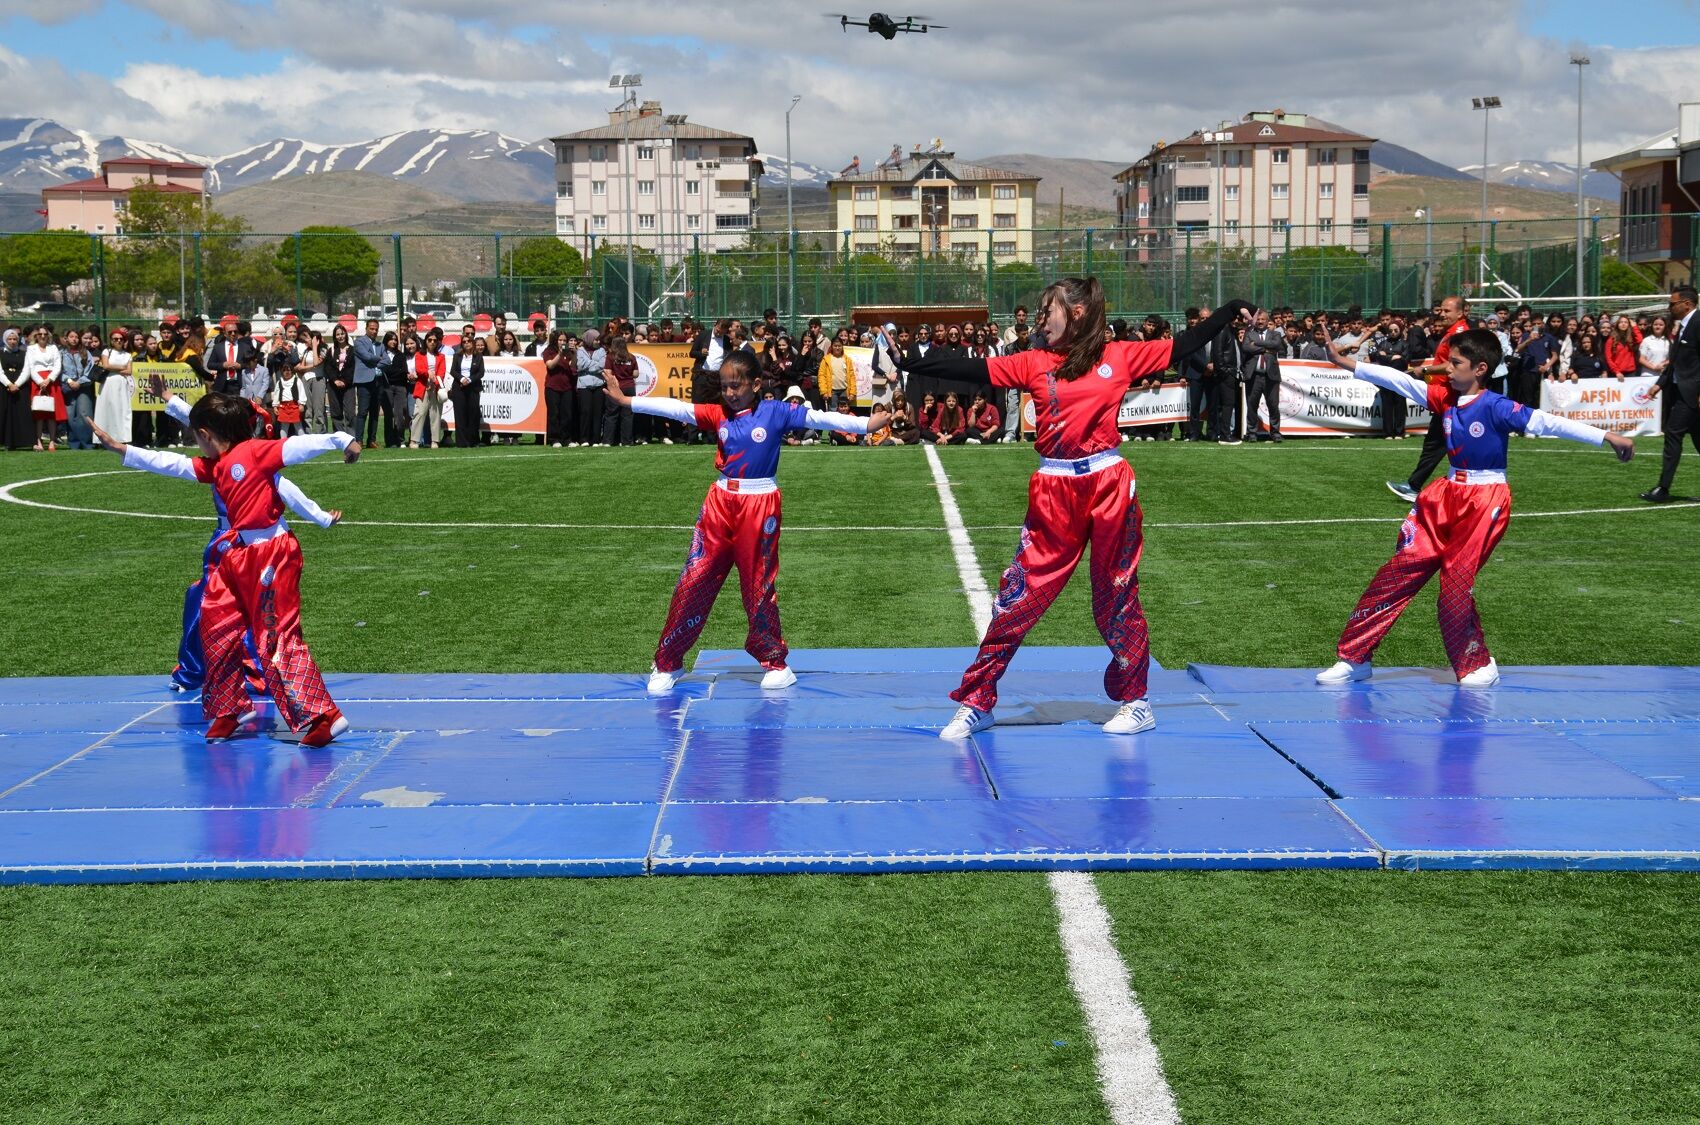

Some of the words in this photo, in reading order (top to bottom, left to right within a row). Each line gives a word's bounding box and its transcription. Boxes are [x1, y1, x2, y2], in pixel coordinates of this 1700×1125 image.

[668, 367, 693, 381] AF
[163, 376, 203, 389] ARAOĞLAN
[495, 380, 513, 395] HAKAN
[514, 381, 532, 395] AKYAR
[138, 392, 156, 404] FEN
[669, 383, 693, 399] LİS
[1580, 387, 1622, 405] AFŞİN
[1127, 404, 1150, 417] TEKNİK
[1152, 403, 1181, 415] ANADOLU
[1307, 404, 1358, 418] ANADOLU
[1567, 408, 1607, 420] MESLEKİ
[1608, 410, 1621, 420] VE
[1622, 408, 1654, 419] TEKNİK
